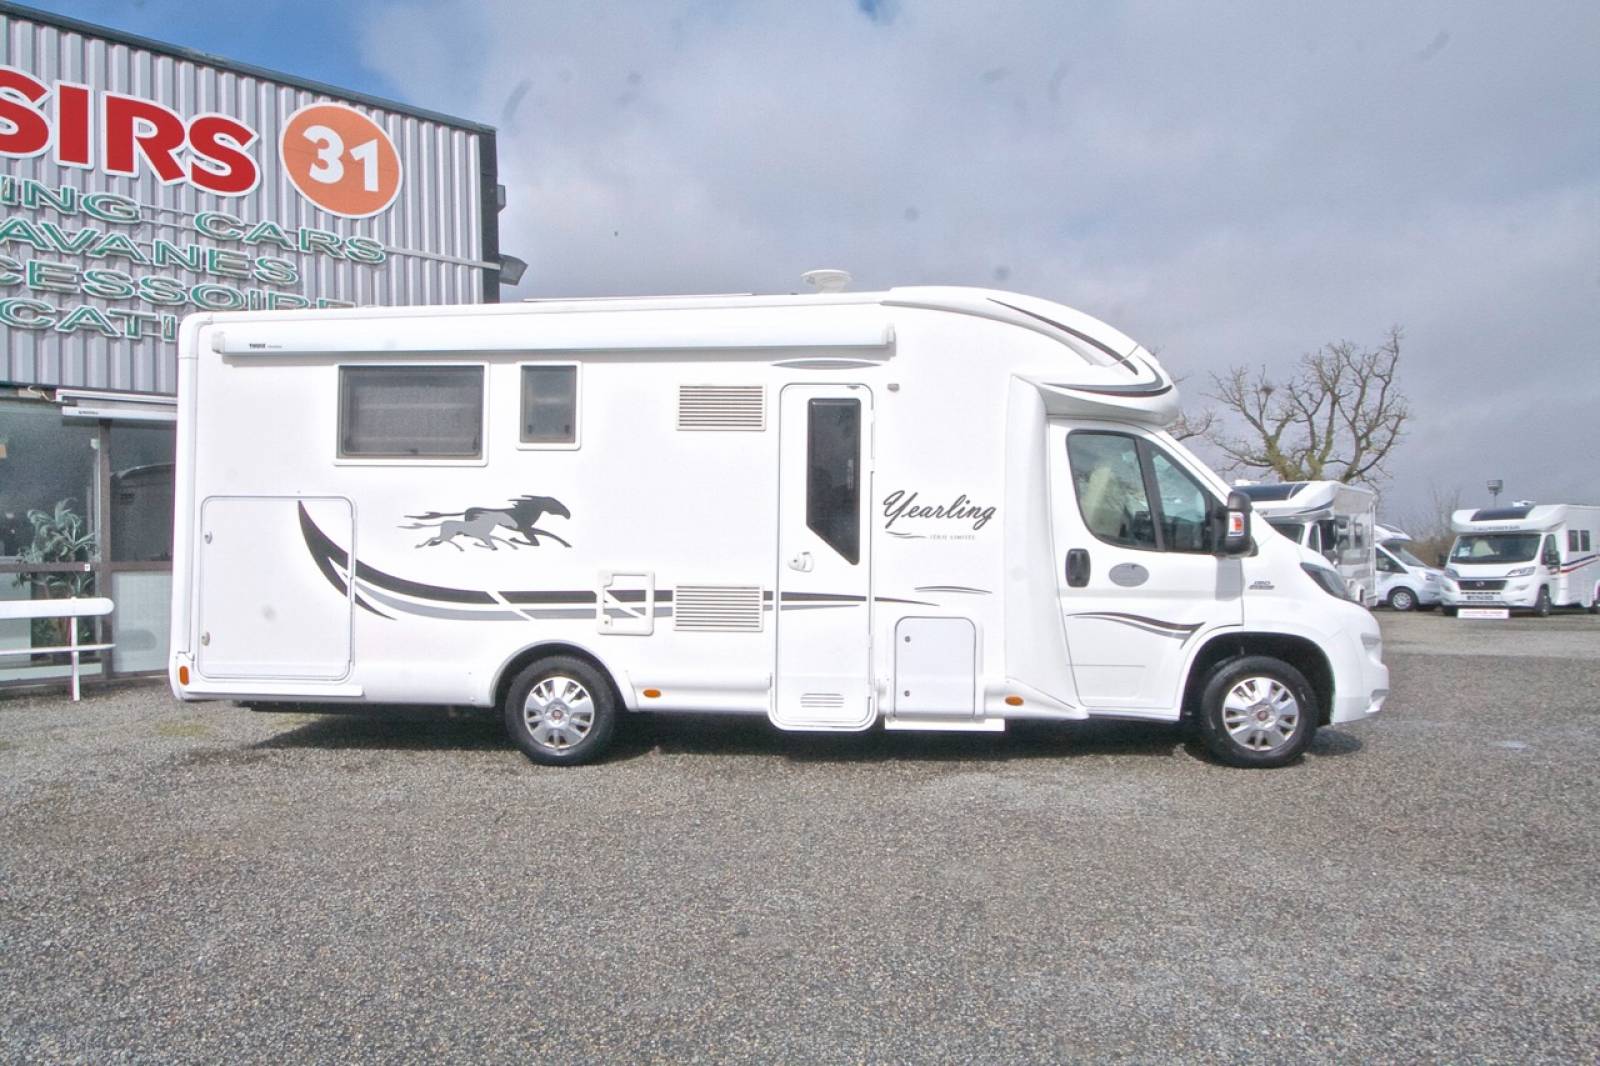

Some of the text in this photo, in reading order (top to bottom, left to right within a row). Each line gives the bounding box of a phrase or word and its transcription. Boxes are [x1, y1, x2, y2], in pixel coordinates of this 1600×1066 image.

[0, 66, 259, 196] SIRS
[302, 124, 379, 192] 31
[0, 175, 386, 264] ING CARS
[0, 216, 299, 286] AVANES
[883, 489, 997, 531] Yearling
